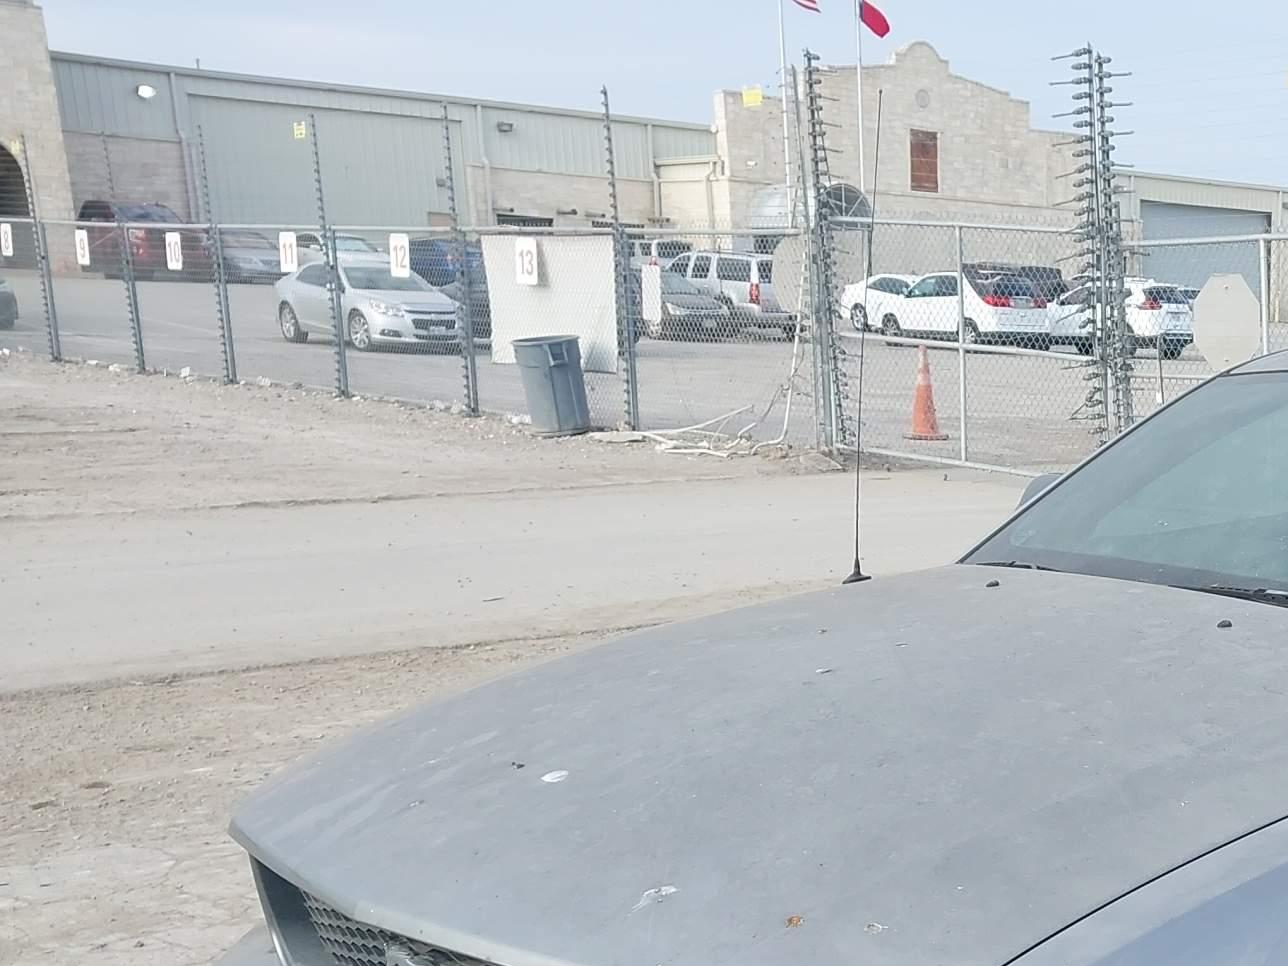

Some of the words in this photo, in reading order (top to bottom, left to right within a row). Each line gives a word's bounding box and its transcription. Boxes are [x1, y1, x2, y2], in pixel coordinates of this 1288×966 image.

[3, 231, 10, 250] 8
[79, 238, 86, 258] 9
[167, 240, 181, 263] 10
[282, 241, 294, 265] 11
[393, 244, 407, 269] 12
[518, 249, 534, 276] 13
